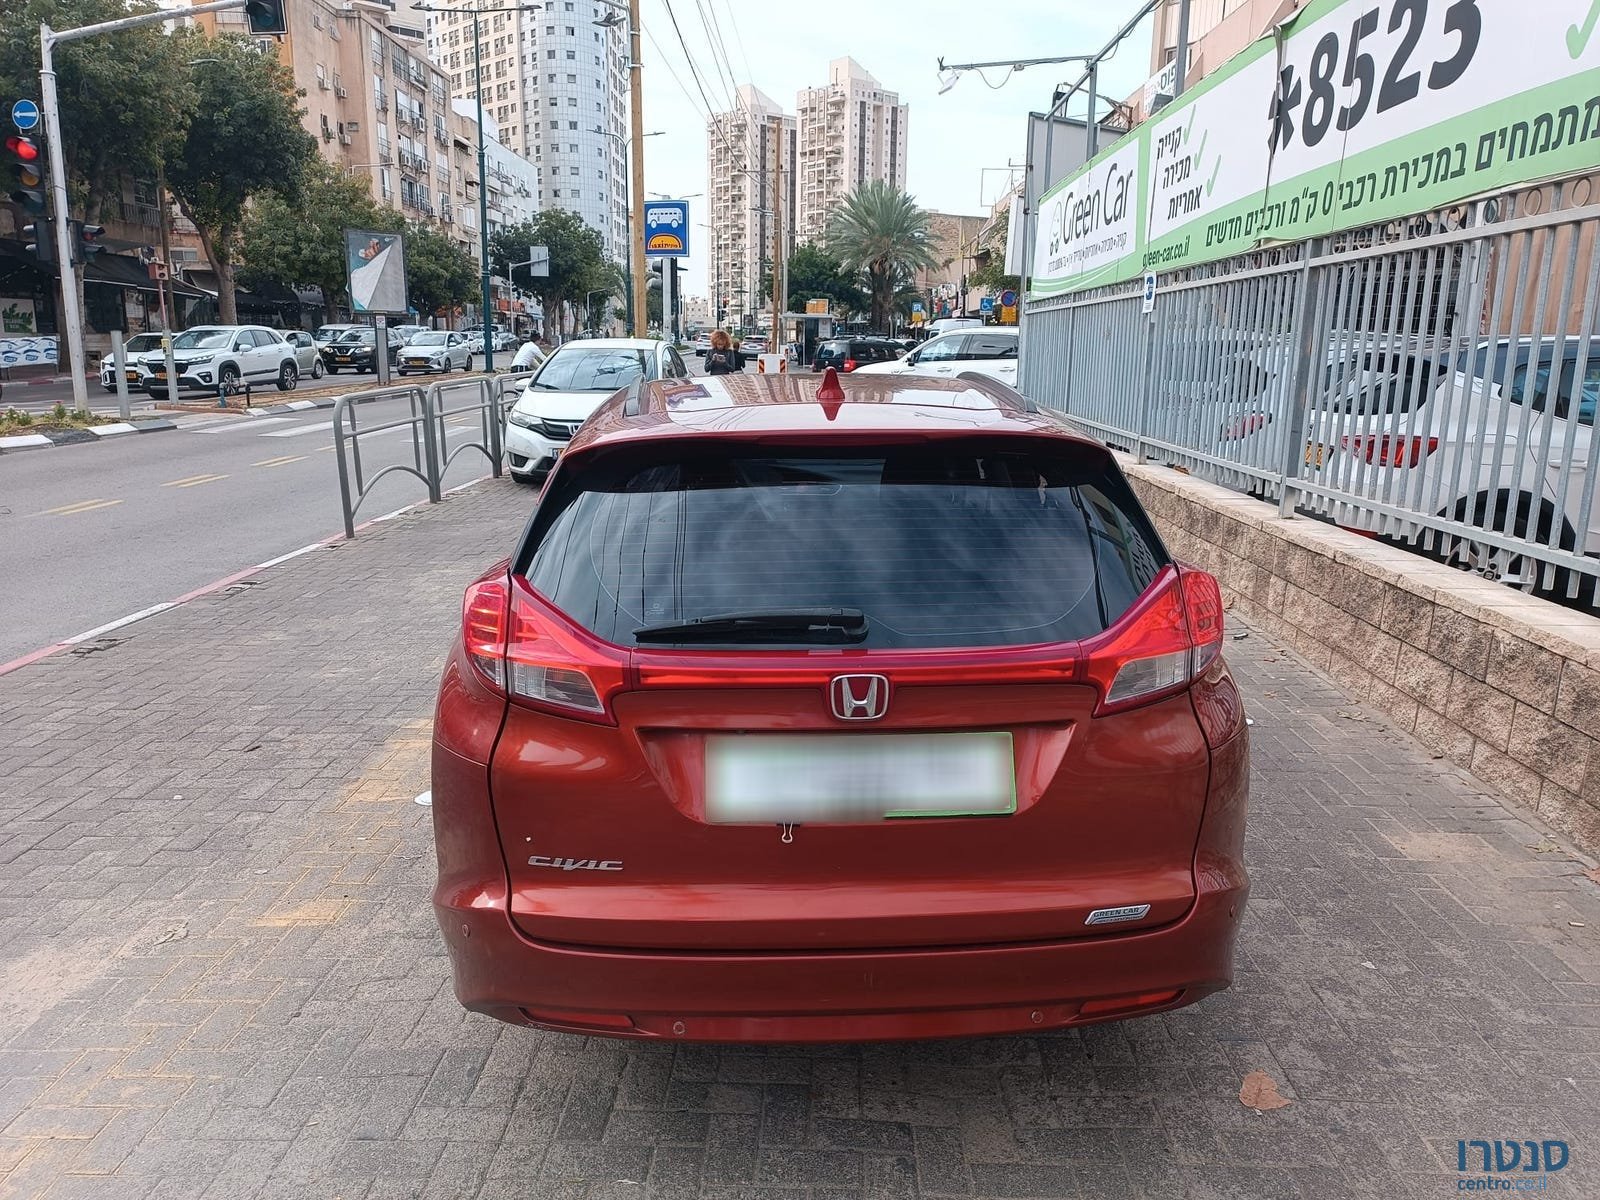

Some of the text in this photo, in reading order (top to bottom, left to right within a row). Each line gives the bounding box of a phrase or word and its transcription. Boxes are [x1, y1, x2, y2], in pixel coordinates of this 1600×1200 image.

[1157, 126, 1182, 159] קנייה
[1474, 96, 1600, 172] מתמחים
[1163, 155, 1191, 189] מכירה
[1380, 142, 1468, 200] במכירת
[1063, 163, 1133, 245] Green Car
[1168, 185, 1203, 220] אחריות
[1339, 172, 1377, 211] רכבי
[1206, 216, 1242, 247] חדשים
[1142, 235, 1190, 267] geen-car.co.il
[527, 855, 624, 871] CIVIC
